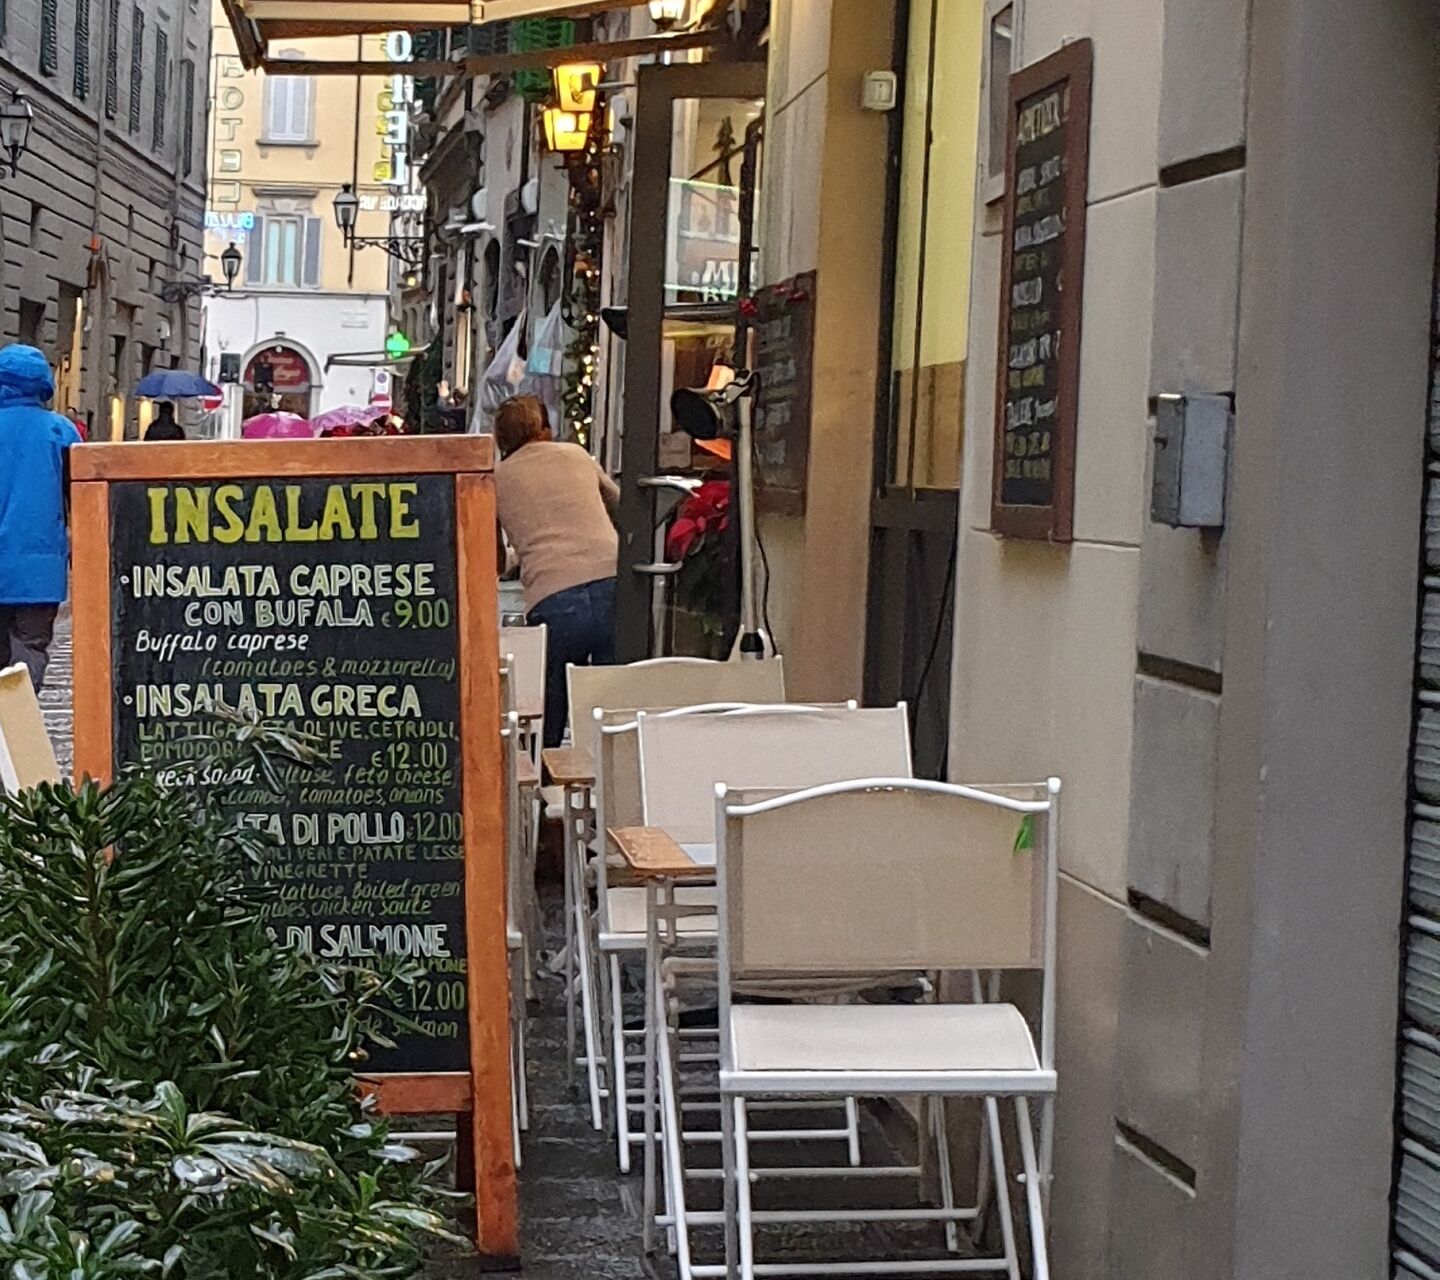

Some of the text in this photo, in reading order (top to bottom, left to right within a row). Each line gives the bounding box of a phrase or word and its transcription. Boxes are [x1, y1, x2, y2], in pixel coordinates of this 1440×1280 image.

[147, 483, 421, 544] INSALATE
[133, 563, 436, 598] INSALATA CAPRESE
[184, 600, 244, 627] CON
[254, 599, 375, 628] BUFALA
[135, 629, 310, 662] Buffalo caprese
[322, 656, 338, 677] &
[135, 683, 422, 718] INSALATA GRECA
[292, 813, 320, 846] DI
[327, 811, 405, 845] POLLO
[286, 925, 313, 955] DI
[319, 924, 452, 958] SALMONE
